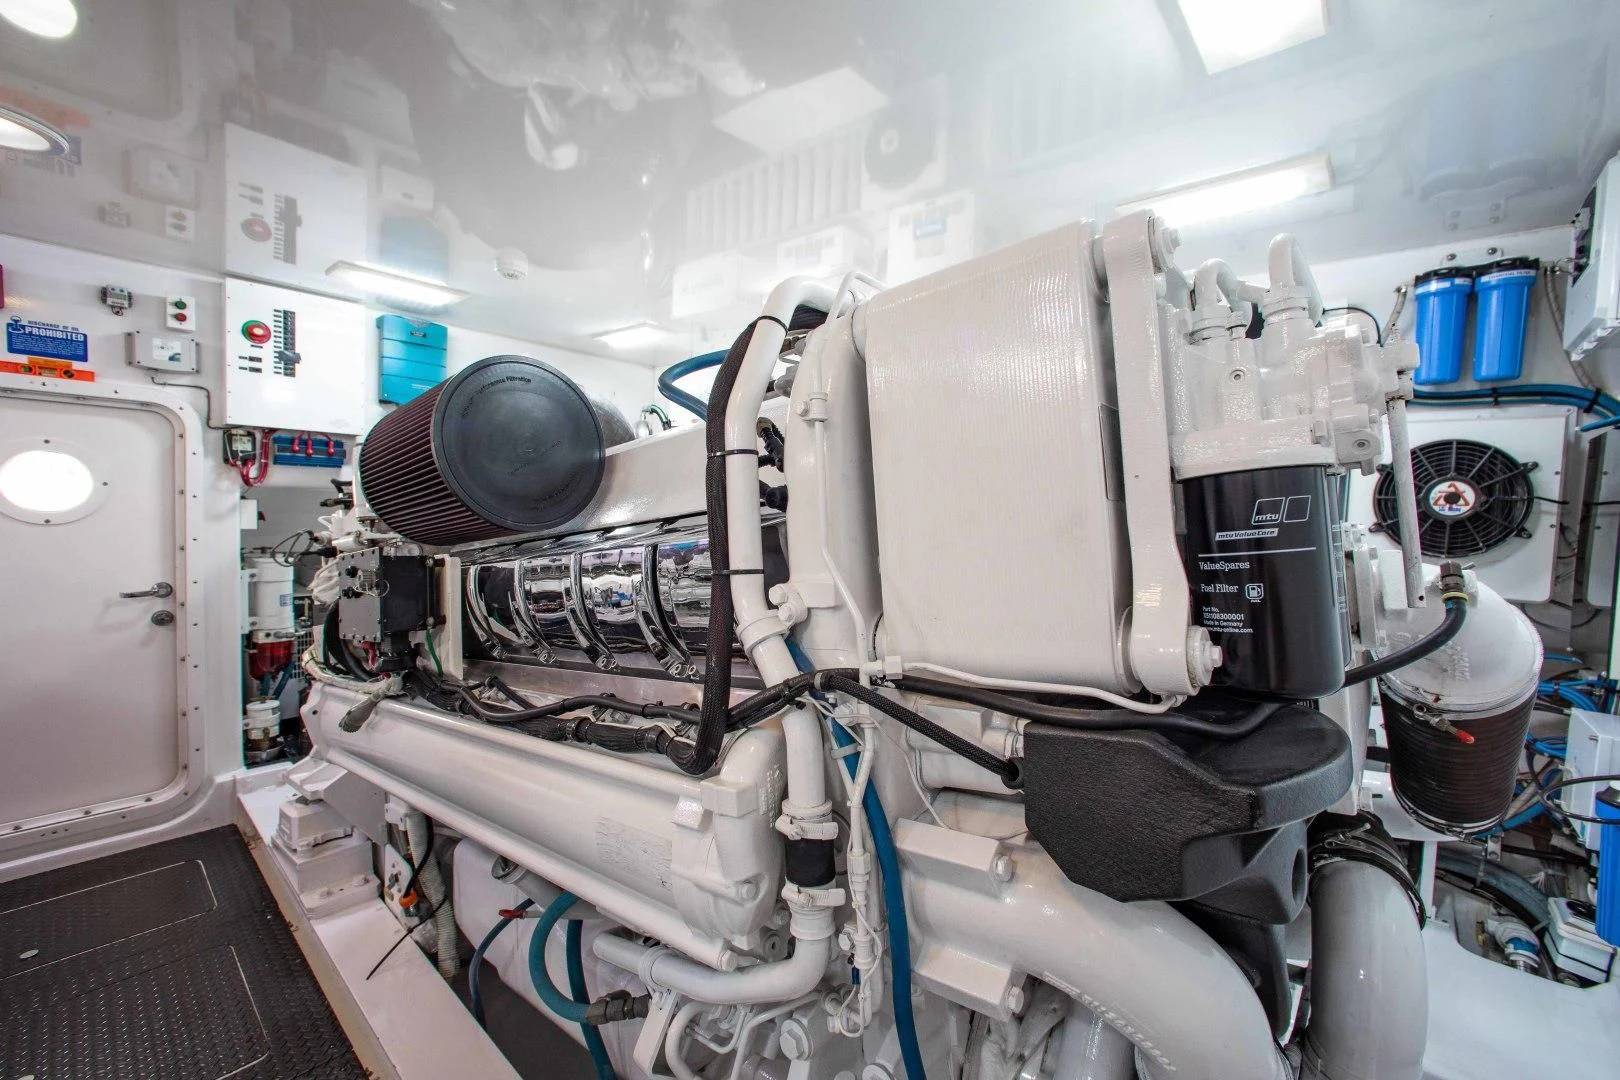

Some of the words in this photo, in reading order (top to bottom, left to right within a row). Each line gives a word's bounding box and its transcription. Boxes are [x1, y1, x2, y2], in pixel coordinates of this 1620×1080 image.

[25, 326, 85, 341] PROHIBITED
[1255, 513, 1279, 521] mtu
[1198, 561, 1250, 571] ValueSpares
[1200, 583, 1215, 592] Fuel
[1215, 583, 1239, 592] Filter
[1219, 620, 1244, 628] Germany
